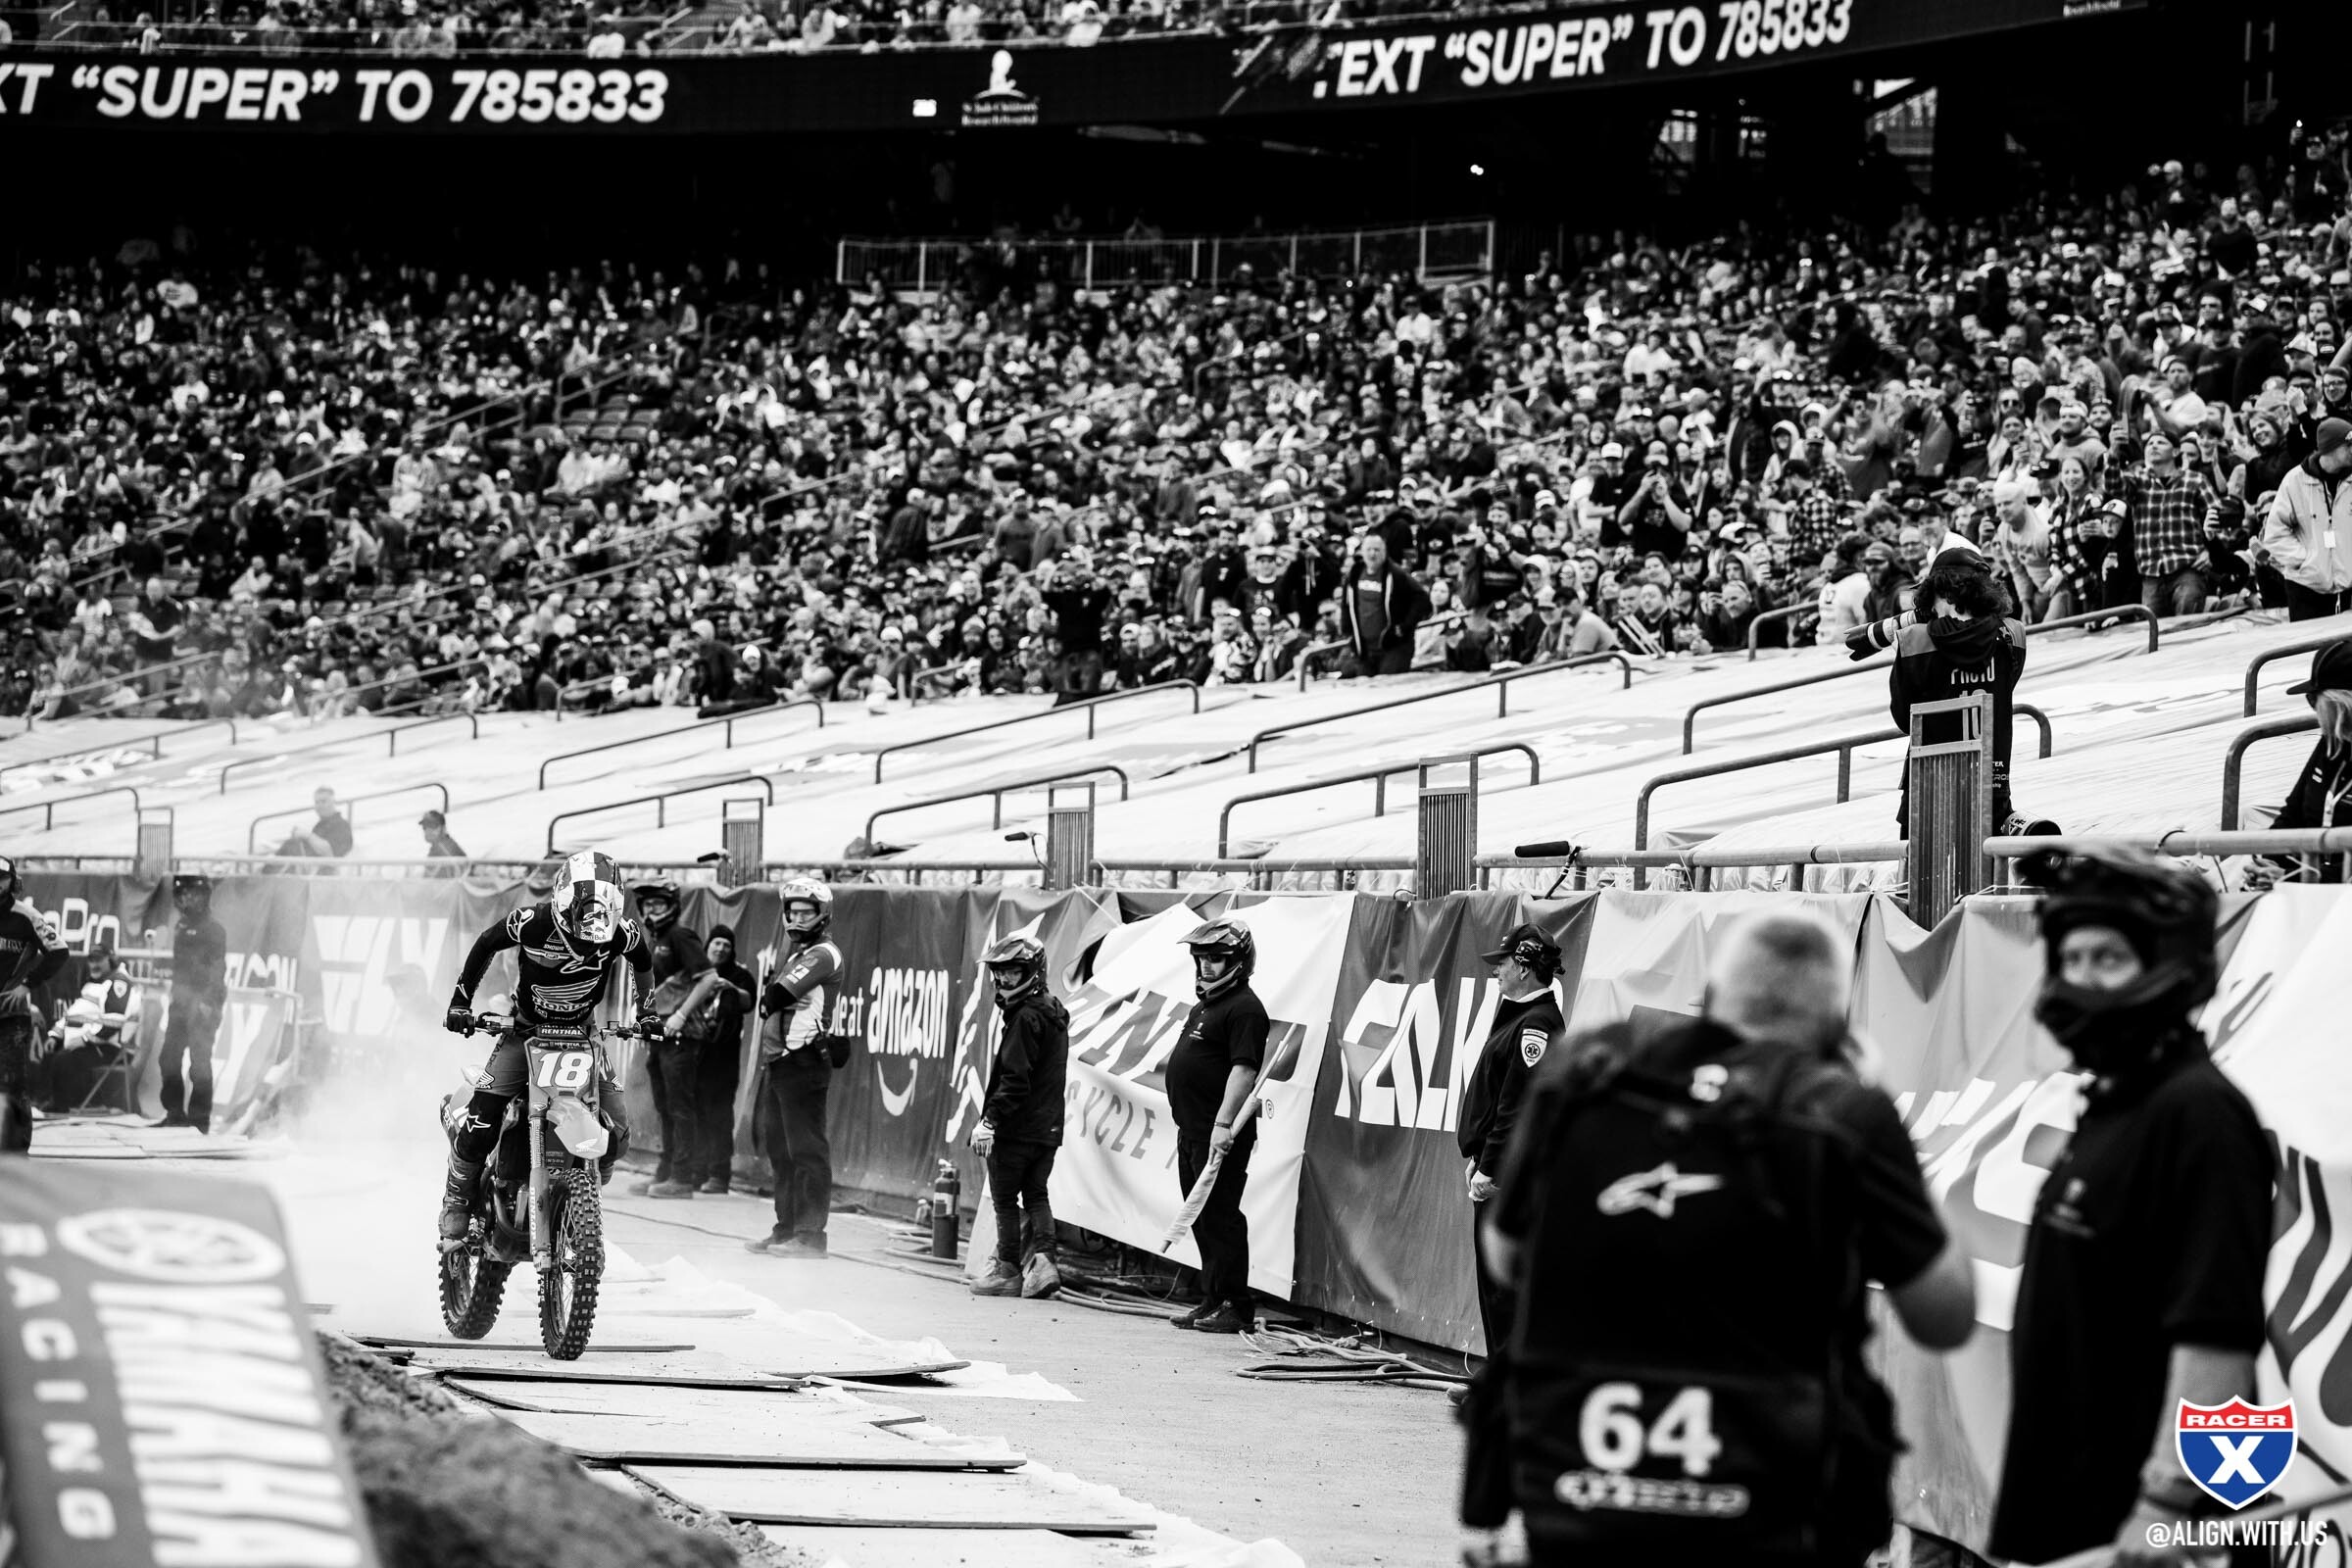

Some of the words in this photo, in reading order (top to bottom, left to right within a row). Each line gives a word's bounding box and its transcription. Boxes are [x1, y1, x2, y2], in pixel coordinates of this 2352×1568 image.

[1645, 7, 1707, 69] TO
[1715, 0, 1853, 63] 785833
[355, 69, 433, 122] TO
[450, 69, 669, 123] 785833
[866, 965, 950, 1059] amazon
[536, 1052, 594, 1088] 18
[0, 1220, 118, 1540] RACING
[1579, 1380, 1723, 1476] 64
